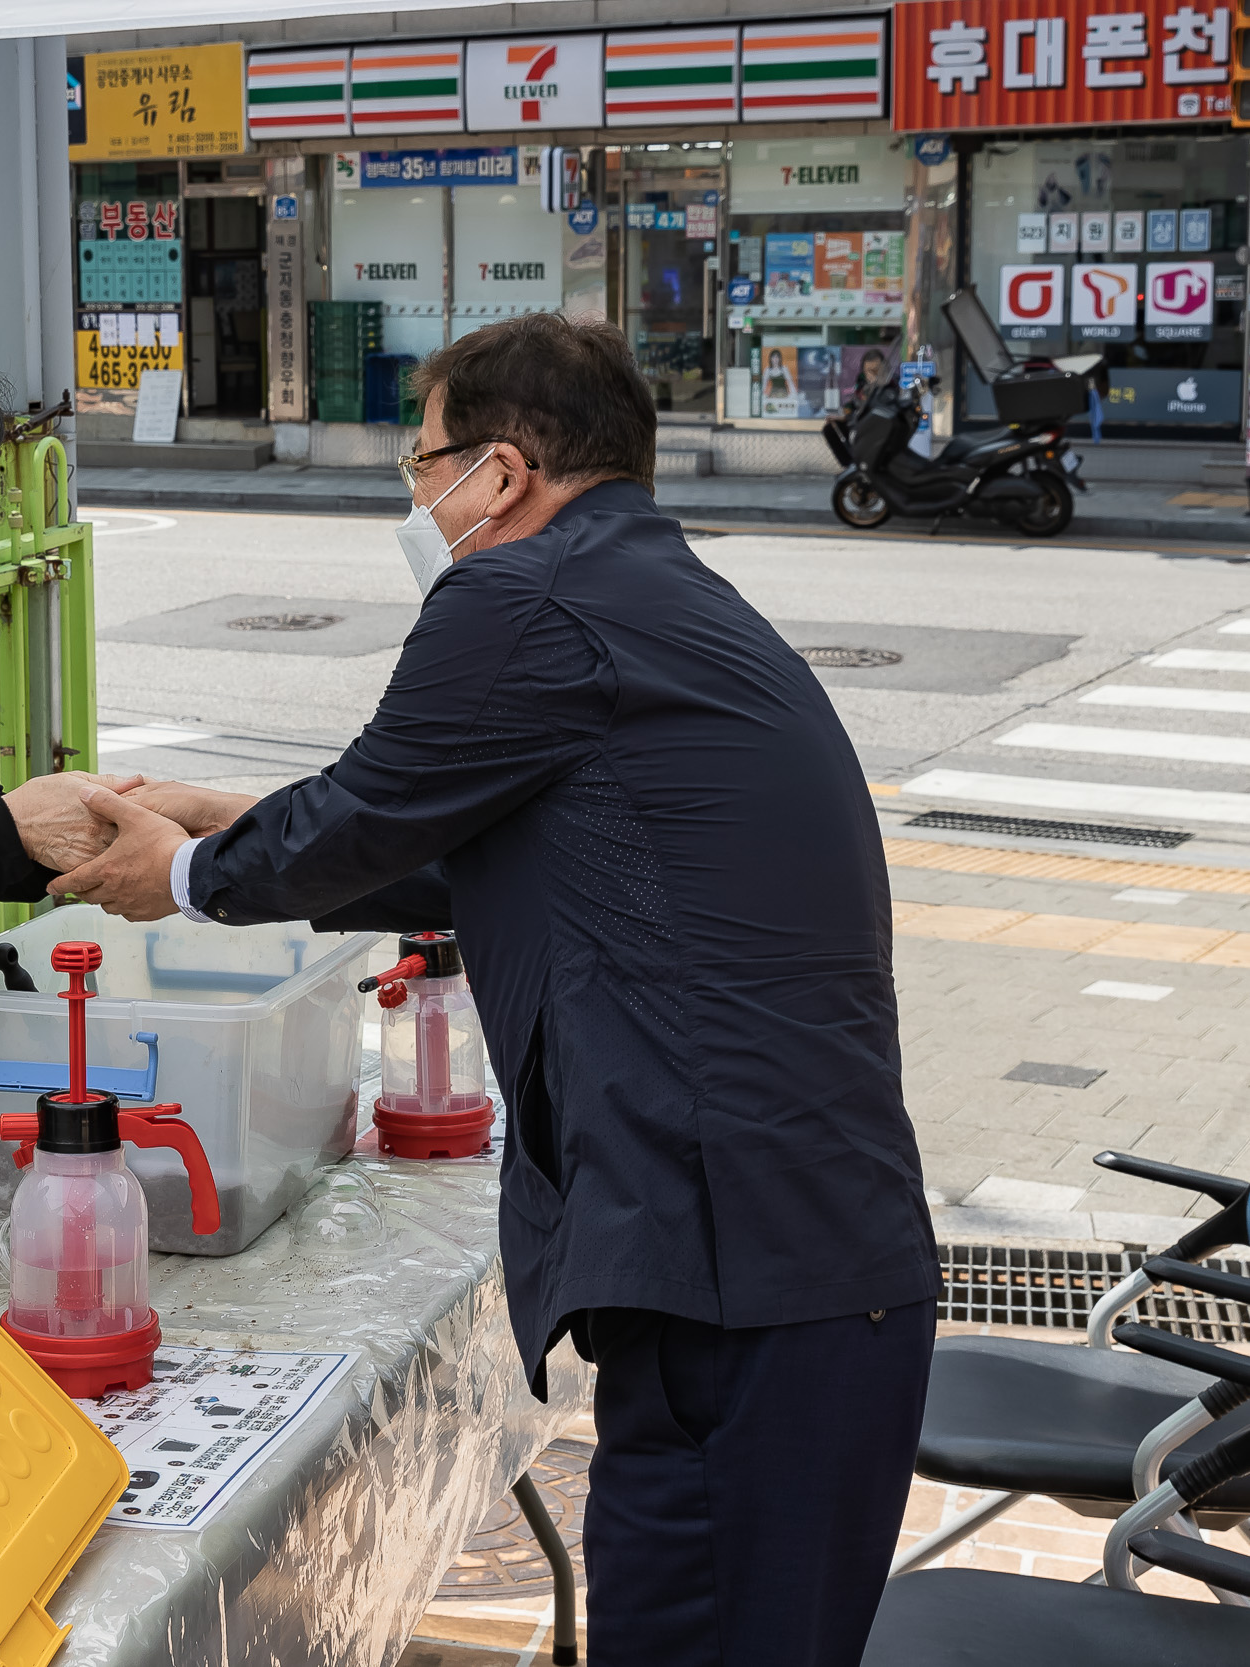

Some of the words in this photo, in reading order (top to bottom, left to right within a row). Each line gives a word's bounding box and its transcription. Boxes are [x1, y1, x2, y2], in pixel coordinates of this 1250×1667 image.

[157, 64, 192, 83] 사무소
[133, 87, 196, 127] 유림
[402, 156, 436, 180] 35년
[478, 155, 513, 178] 미래
[100, 201, 178, 242] 부동산
[1081, 327, 1121, 338] WORLD
[1155, 327, 1203, 338] SQUARE
[1167, 401, 1207, 413] iPhone
